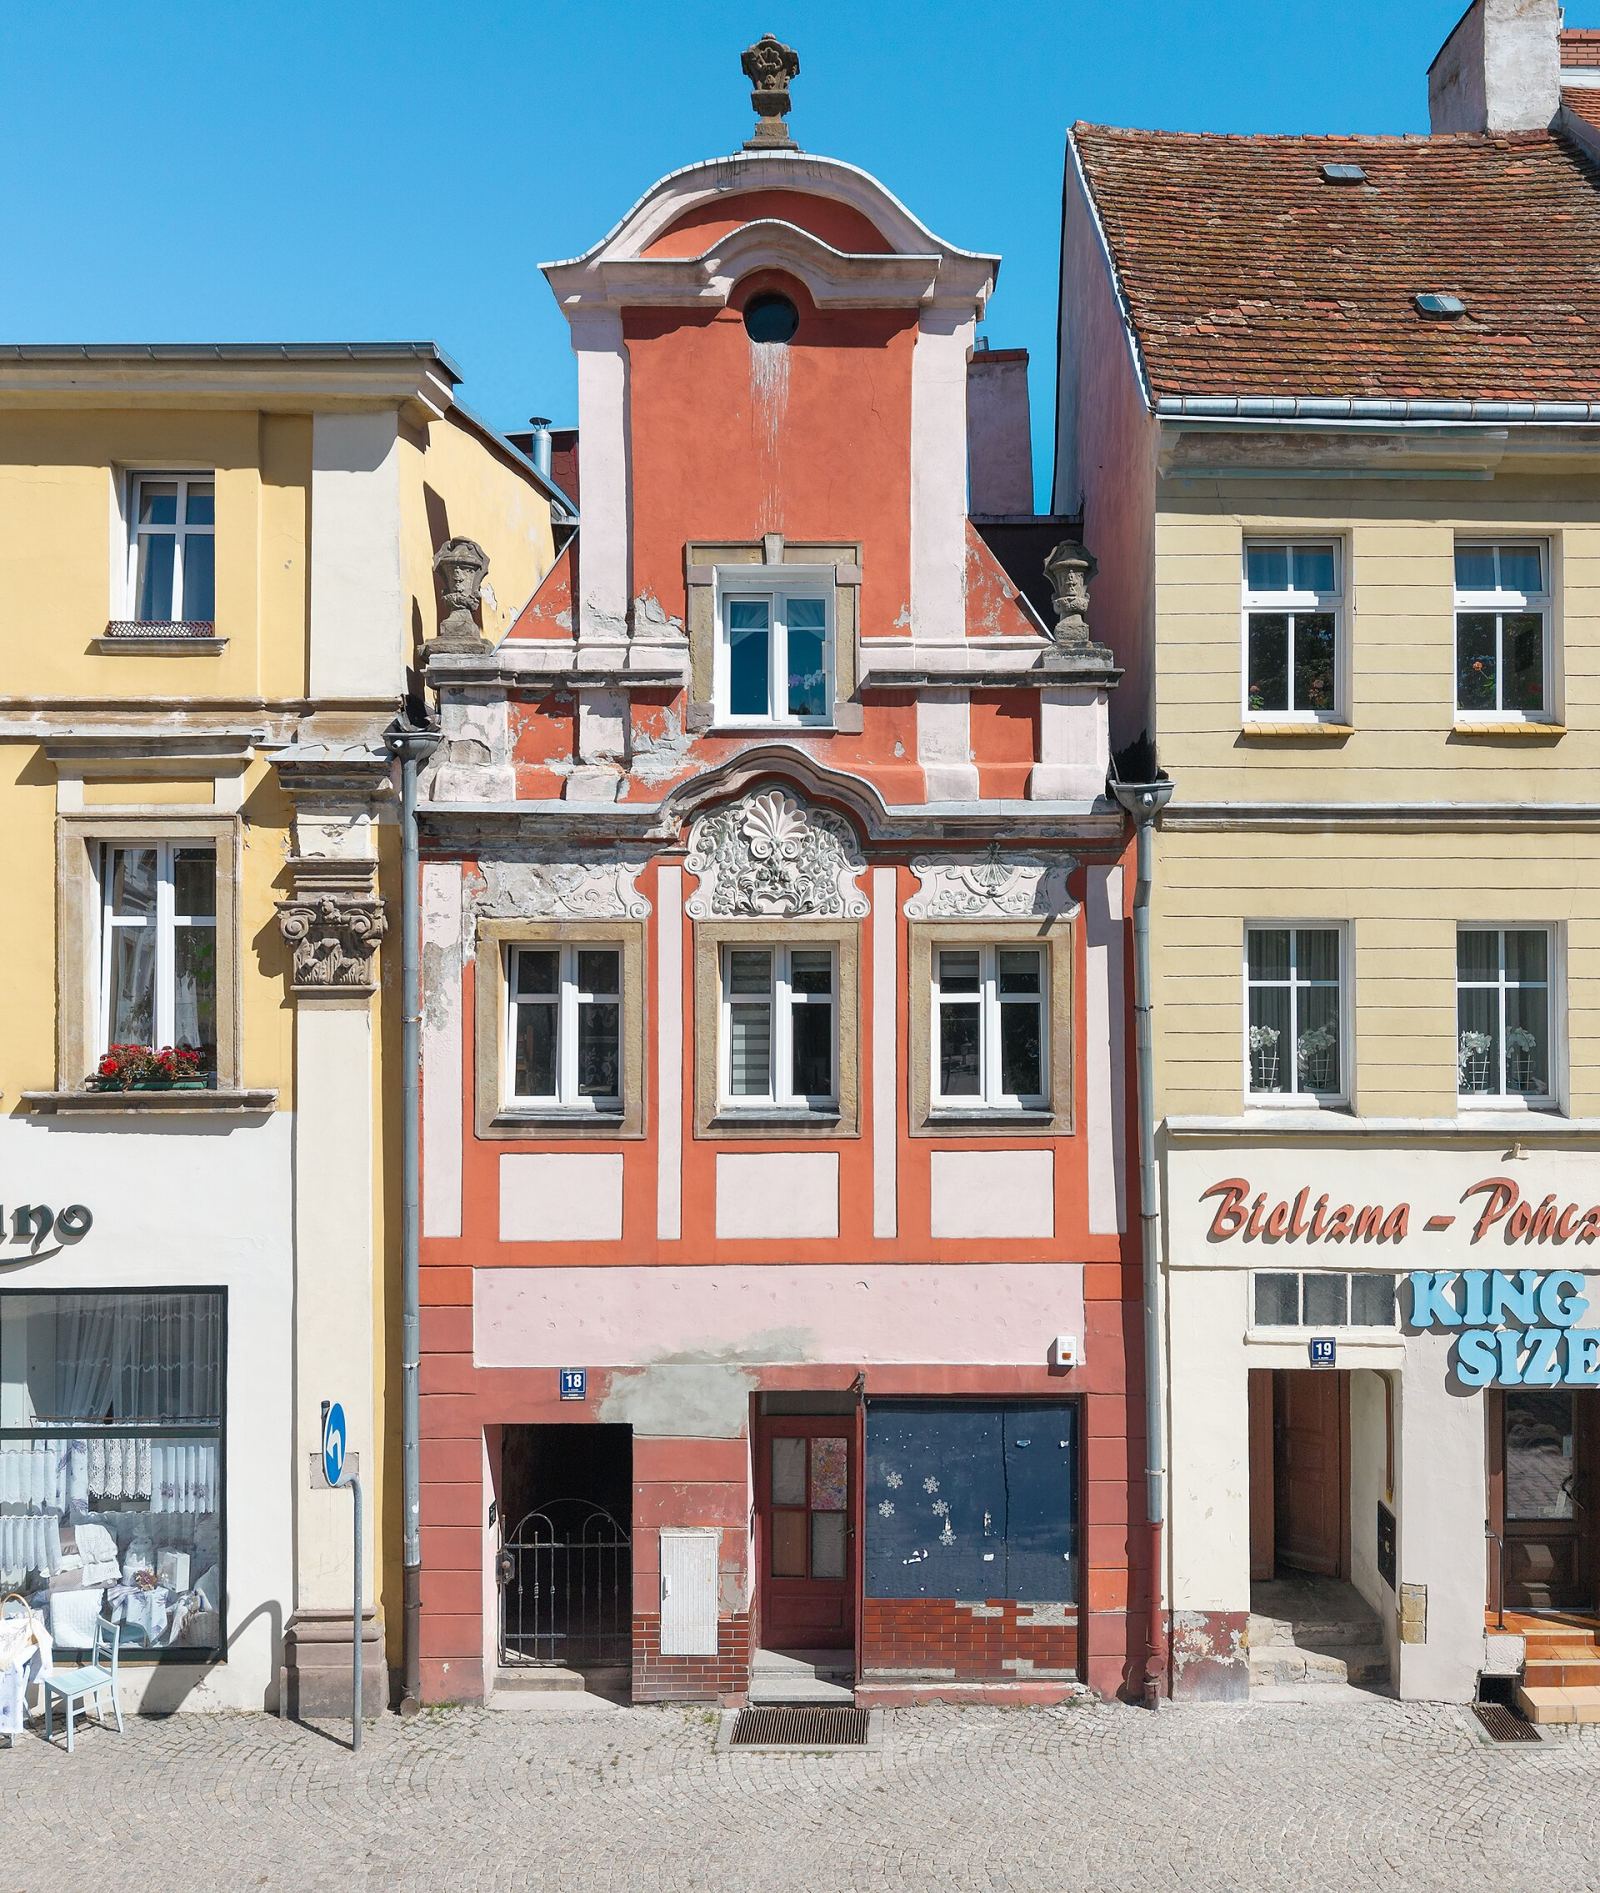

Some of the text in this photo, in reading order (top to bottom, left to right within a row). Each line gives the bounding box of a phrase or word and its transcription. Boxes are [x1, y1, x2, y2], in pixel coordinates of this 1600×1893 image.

[0, 1204, 93, 1247] no
[1203, 1178, 1410, 1238] Bielizna
[1410, 1270, 1590, 1327] KING
[1316, 1342, 1332, 1356] 19
[1457, 1329, 1600, 1386] SIZE
[566, 1374, 582, 1388] 18
